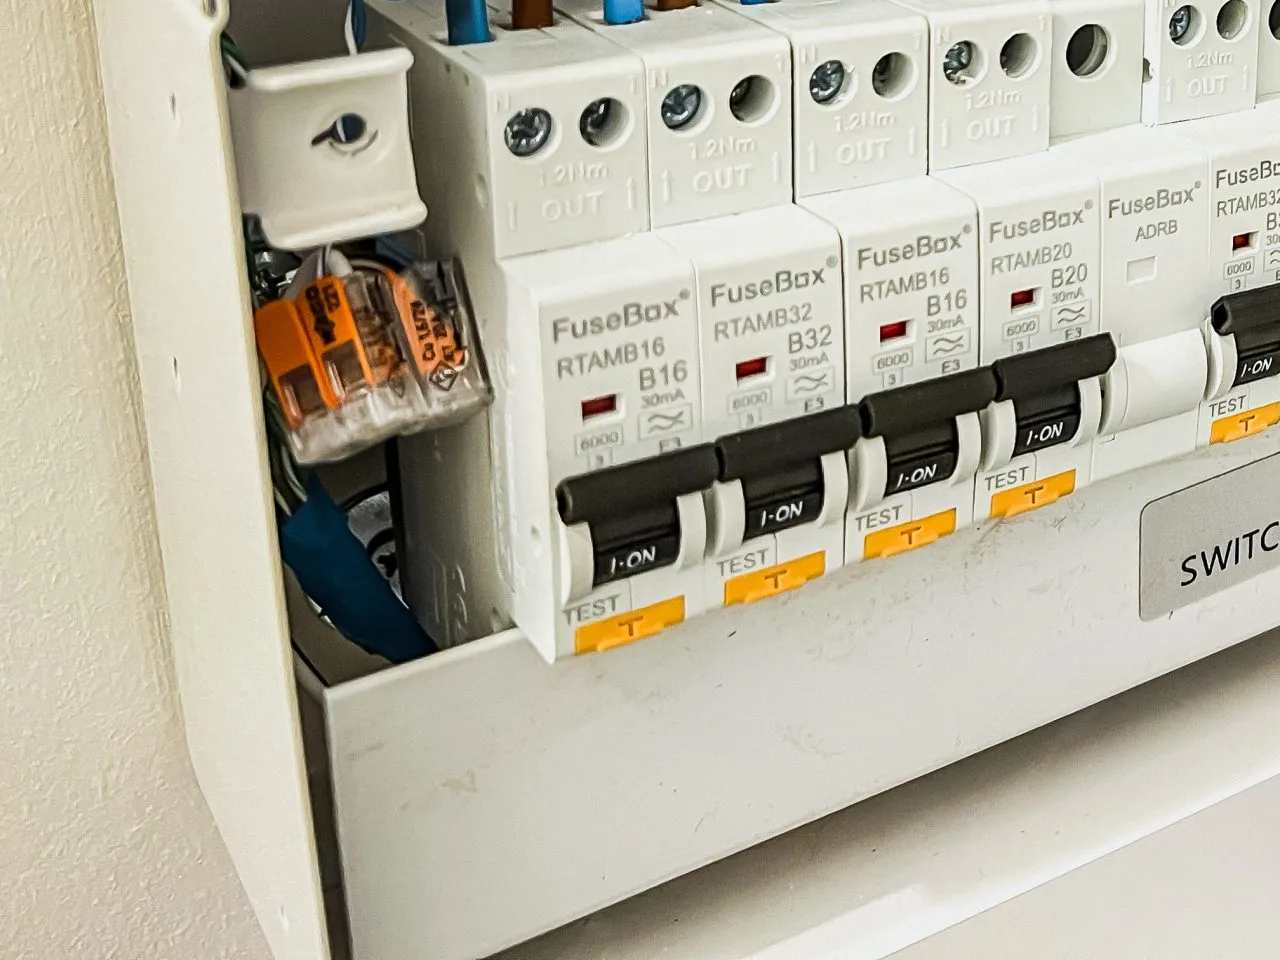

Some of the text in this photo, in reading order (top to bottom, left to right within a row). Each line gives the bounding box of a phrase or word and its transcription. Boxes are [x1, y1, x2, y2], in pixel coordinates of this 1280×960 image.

[1186, 51, 1233, 69] 1.2Nm
[1187, 74, 1228, 97] OUT
[965, 88, 1020, 112] 1.2Nm
[967, 114, 1017, 140] OUT
[690, 136, 756, 160] 1.2Nm
[836, 137, 892, 164] OUT
[692, 165, 751, 194] OUT
[541, 190, 603, 221] OUT
[1135, 220, 1178, 242] ADRB
[991, 242, 1072, 275] RTAMB20
[860, 266, 949, 303] RTAMB16
[1051, 263, 1087, 288] B20
[927, 288, 967, 316] B16
[1052, 287, 1084, 304] 30mA
[714, 302, 812, 342] RTAMB32
[928, 314, 964, 333] 30mA
[1006, 320, 1036, 336] 6000
[788, 324, 832, 353] B32
[557, 336, 665, 381] RTAMB16
[790, 351, 828, 371] 30mA
[877, 352, 909, 370] 6000
[942, 359, 960, 374] E3
[639, 359, 688, 391] B16
[641, 388, 685, 409] 30mA
[1209, 395, 1247, 418] TEST
[1239, 415, 1255, 432] T
[984, 466, 1030, 490] TEST
[1024, 486, 1044, 504] T
[855, 505, 903, 531] TEST
[901, 526, 922, 545] T
[716, 548, 769, 577] TEST
[764, 570, 788, 589] T
[563, 594, 620, 625] TEST
[618, 616, 644, 637] T
